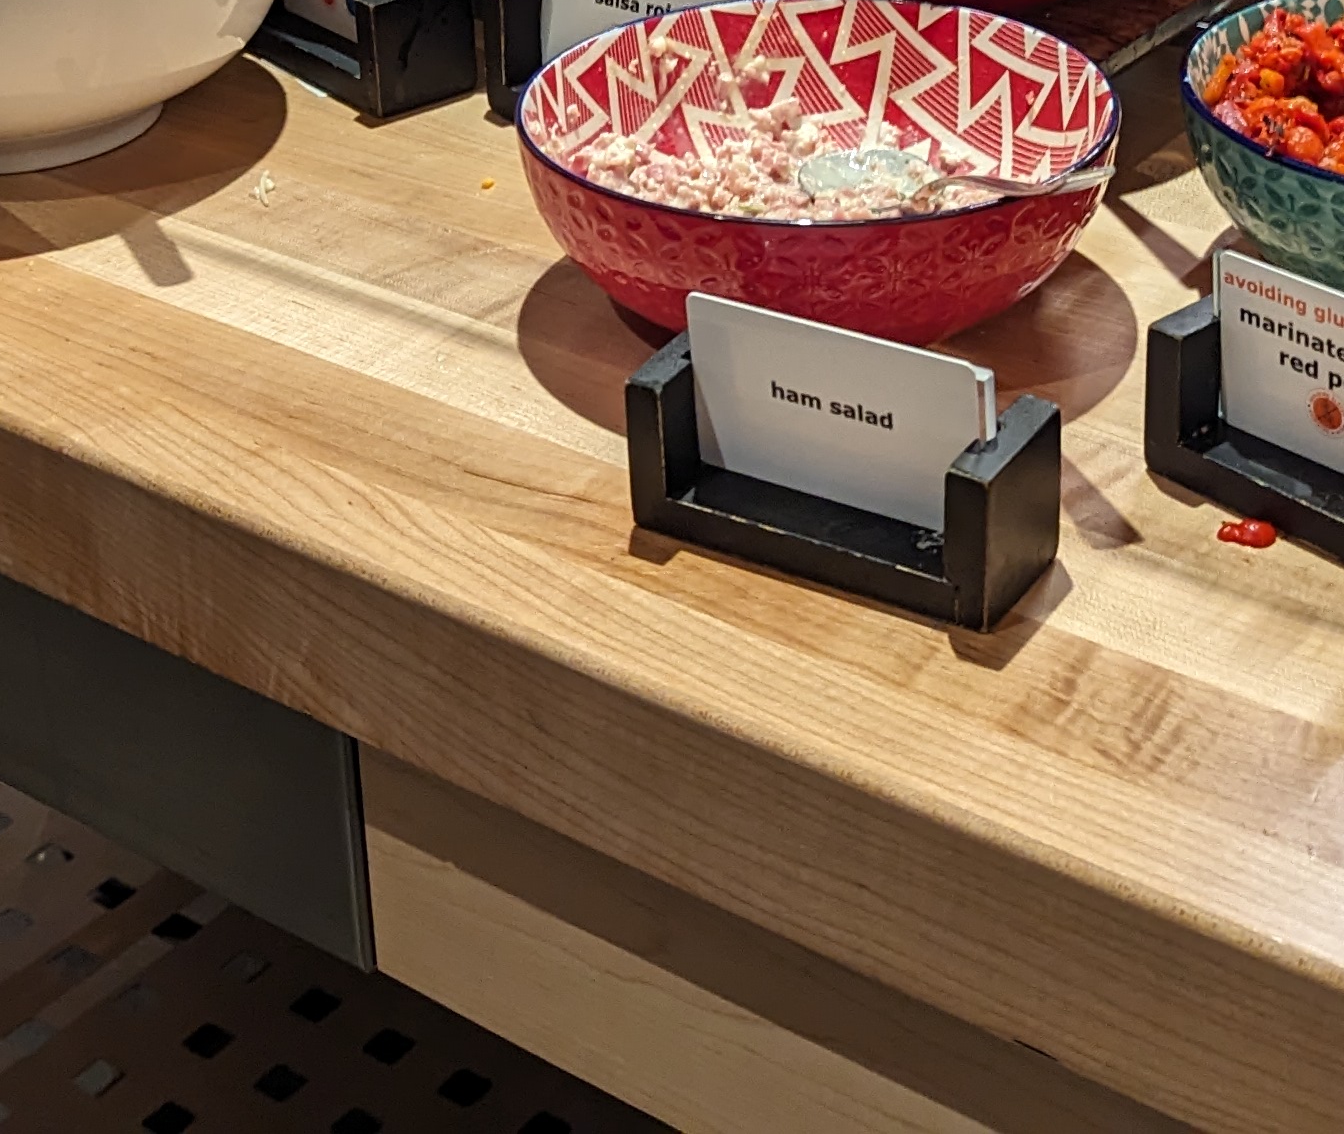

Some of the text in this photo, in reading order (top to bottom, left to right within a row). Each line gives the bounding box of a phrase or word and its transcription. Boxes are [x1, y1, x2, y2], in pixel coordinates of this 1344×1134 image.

[1223, 270, 1307, 316] avoiding
[1279, 350, 1319, 379] red
[771, 380, 893, 430] ham salad
